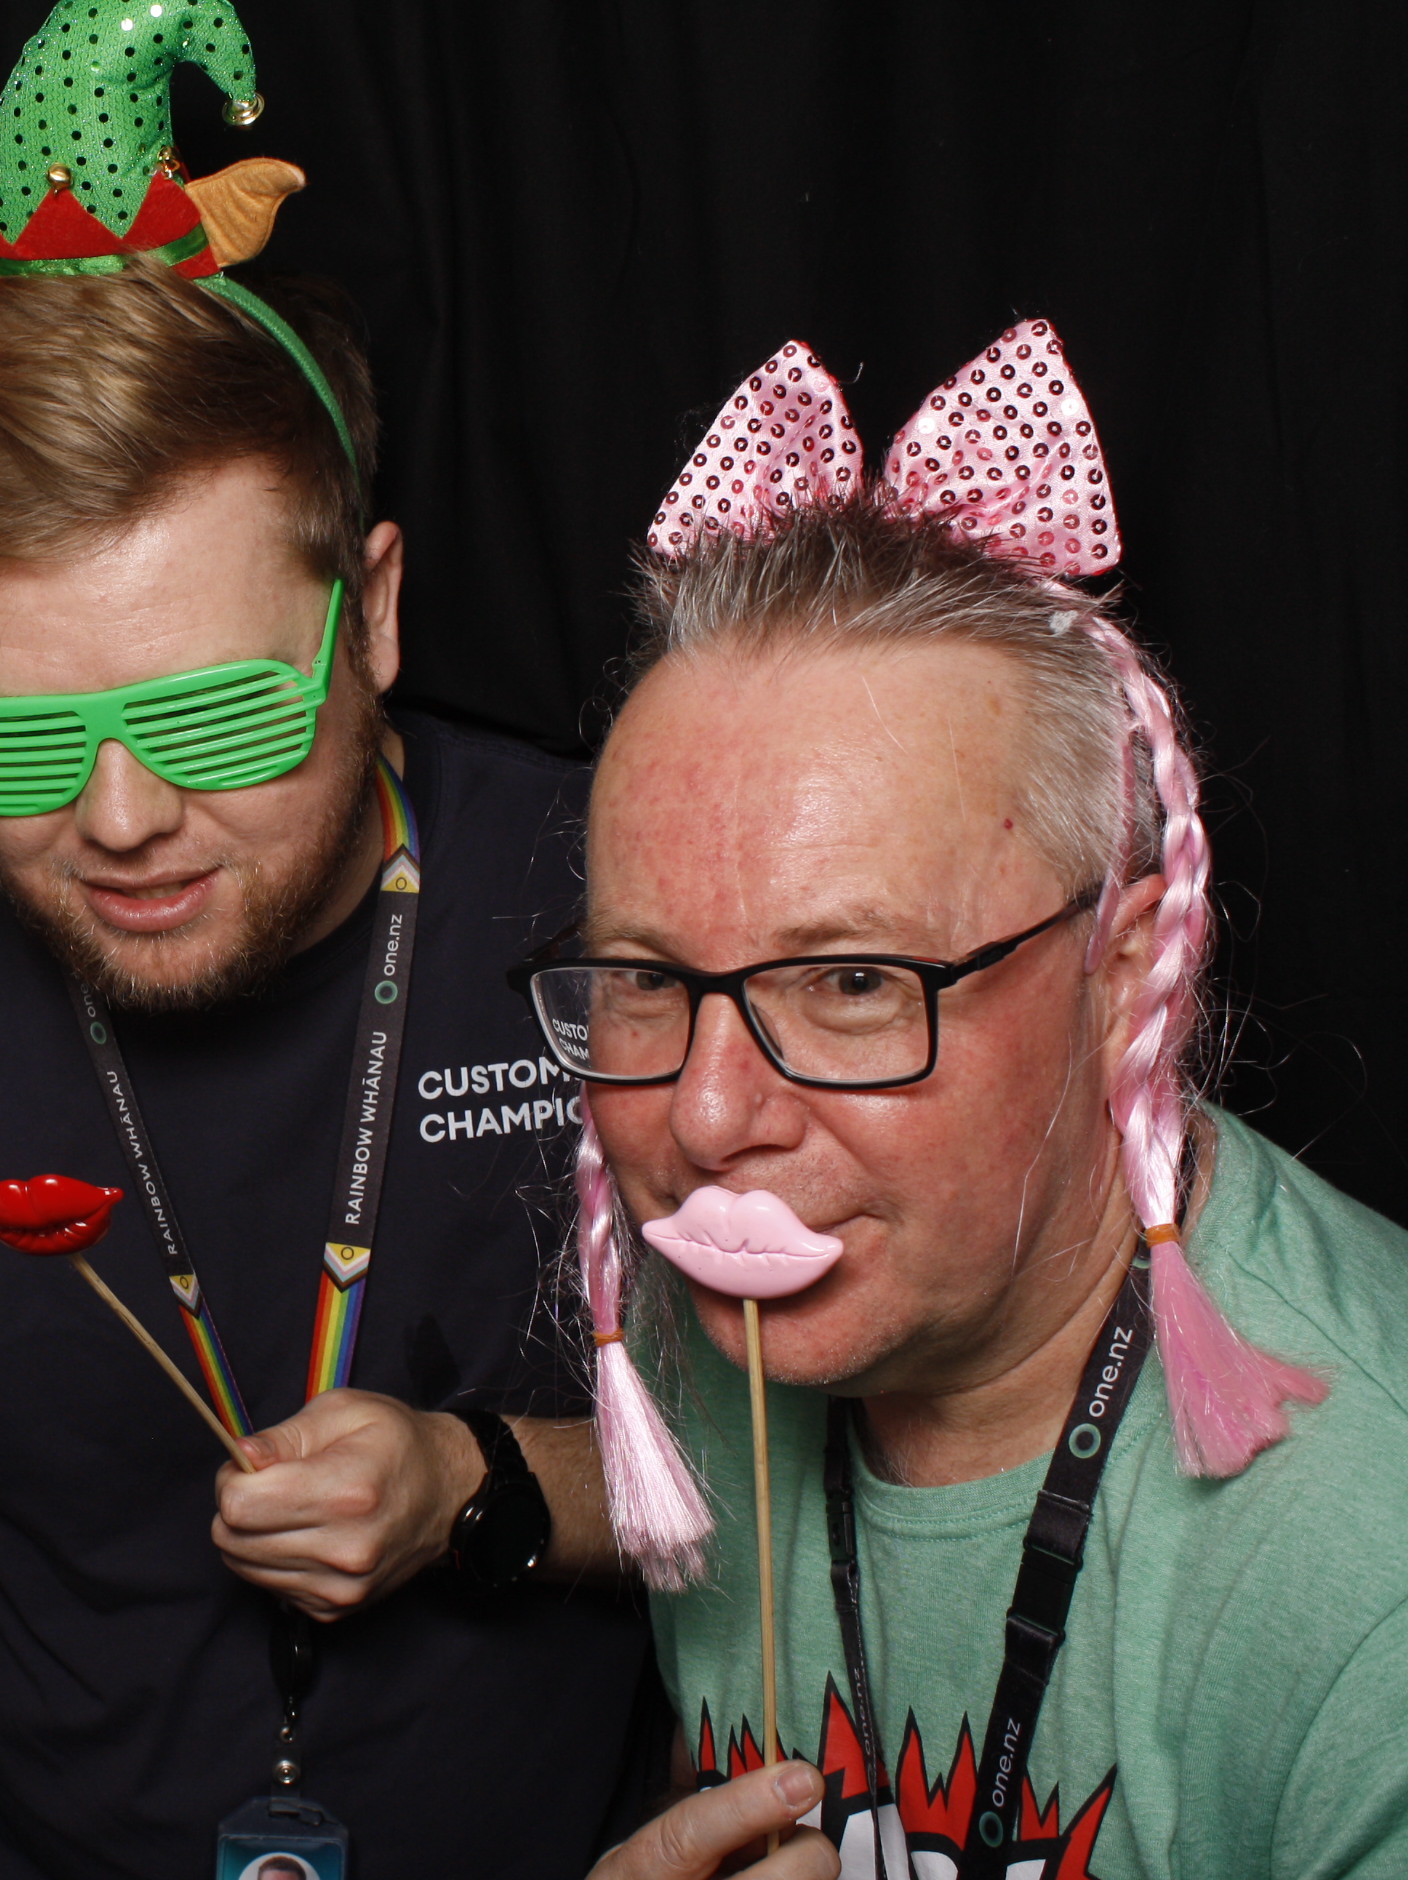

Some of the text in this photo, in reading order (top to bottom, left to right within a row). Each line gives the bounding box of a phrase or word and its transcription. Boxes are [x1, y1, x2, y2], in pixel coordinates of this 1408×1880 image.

[383, 914, 403, 977] one.nz
[80, 983, 97, 1018] one
[552, 1018, 589, 1041] CUSTO
[417, 1056, 572, 1100] CUSTOM
[344, 1031, 389, 1226] RAINBOW WHĀNAU
[419, 1096, 584, 1143] CHAMPIO
[106, 1070, 179, 1256] RAINBOW WHĀNAU
[1088, 1325, 1134, 1418] one.nz
[992, 1718, 1022, 1807] one.nz
